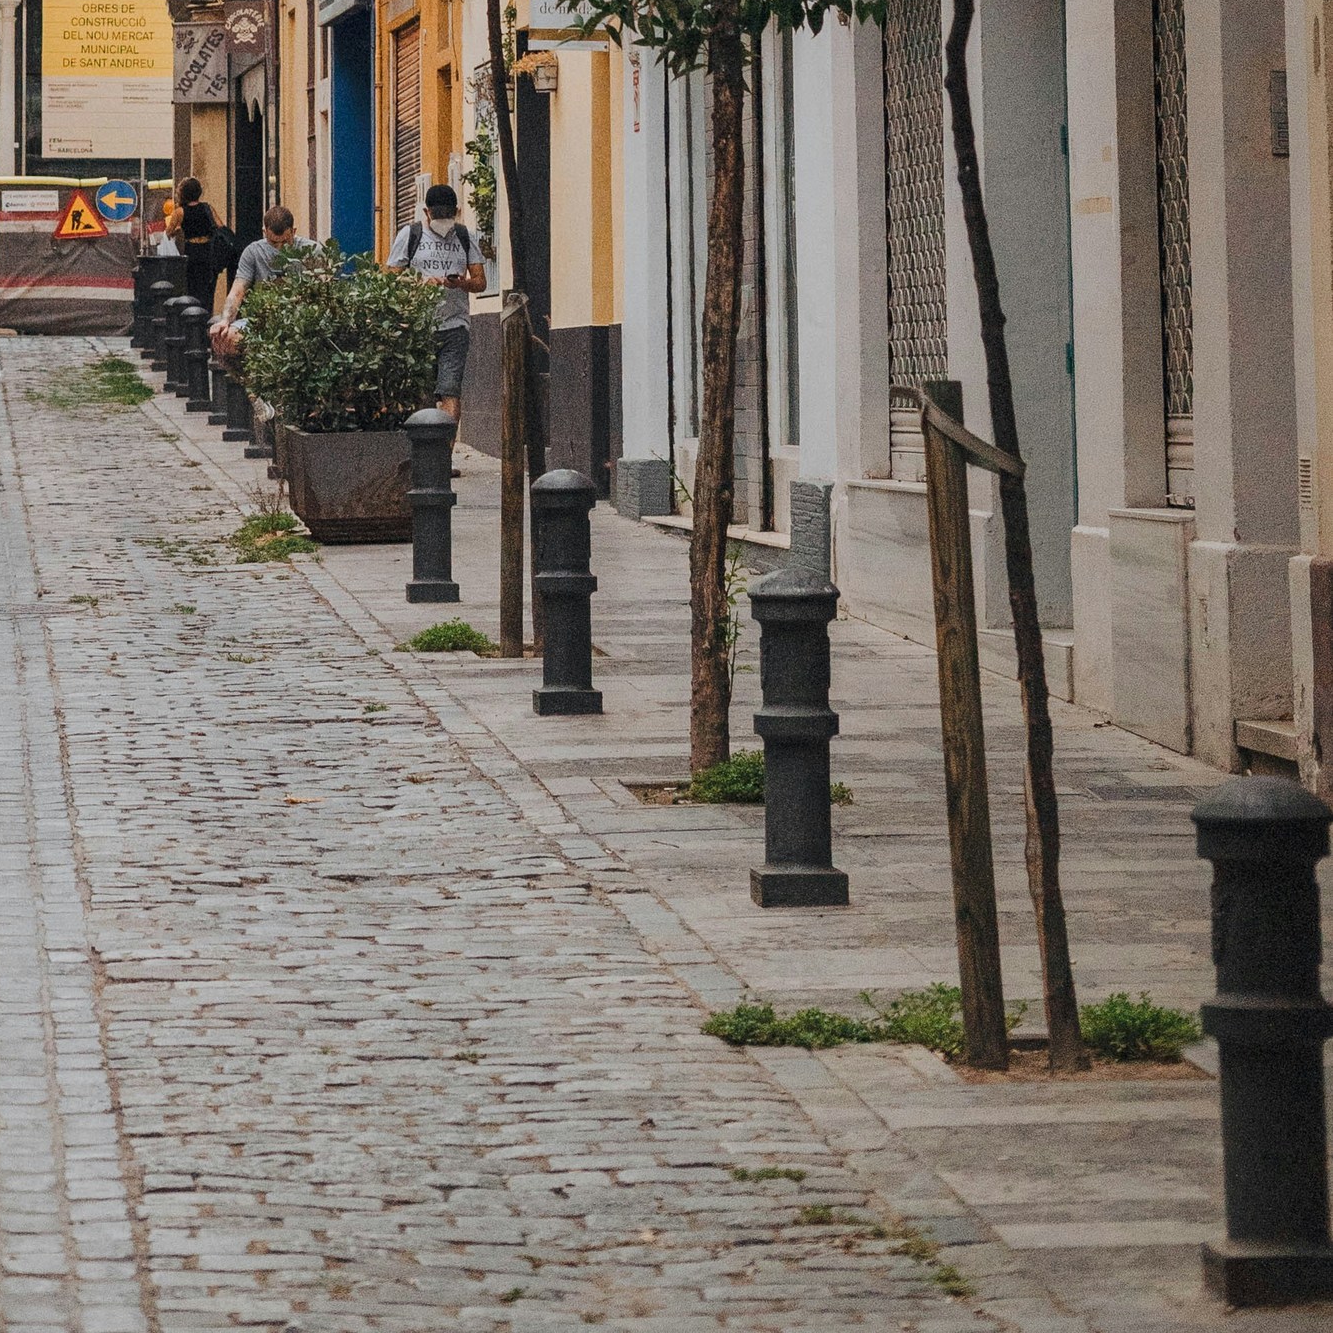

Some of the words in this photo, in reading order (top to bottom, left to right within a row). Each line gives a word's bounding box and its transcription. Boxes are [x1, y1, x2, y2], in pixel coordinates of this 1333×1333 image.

[82, 3, 118, 13] OBRES
[121, 4, 135, 13] DE
[71, 16, 147, 27] CONSTRUCCIÓ
[63, 31, 83, 40] DEL
[86, 31, 109, 40] NOU
[112, 31, 155, 41] MERCAT
[81, 44, 139, 54] MUNICIPAL
[62, 58, 77, 67] DE
[79, 58, 107, 68] SANT
[110, 58, 155, 68] ANDREU
[174, 29, 225, 97] XOCOLATES
[205, 73, 227, 97] TES
[419, 241, 460, 252] BYRON
[423, 259, 453, 270] NSW
